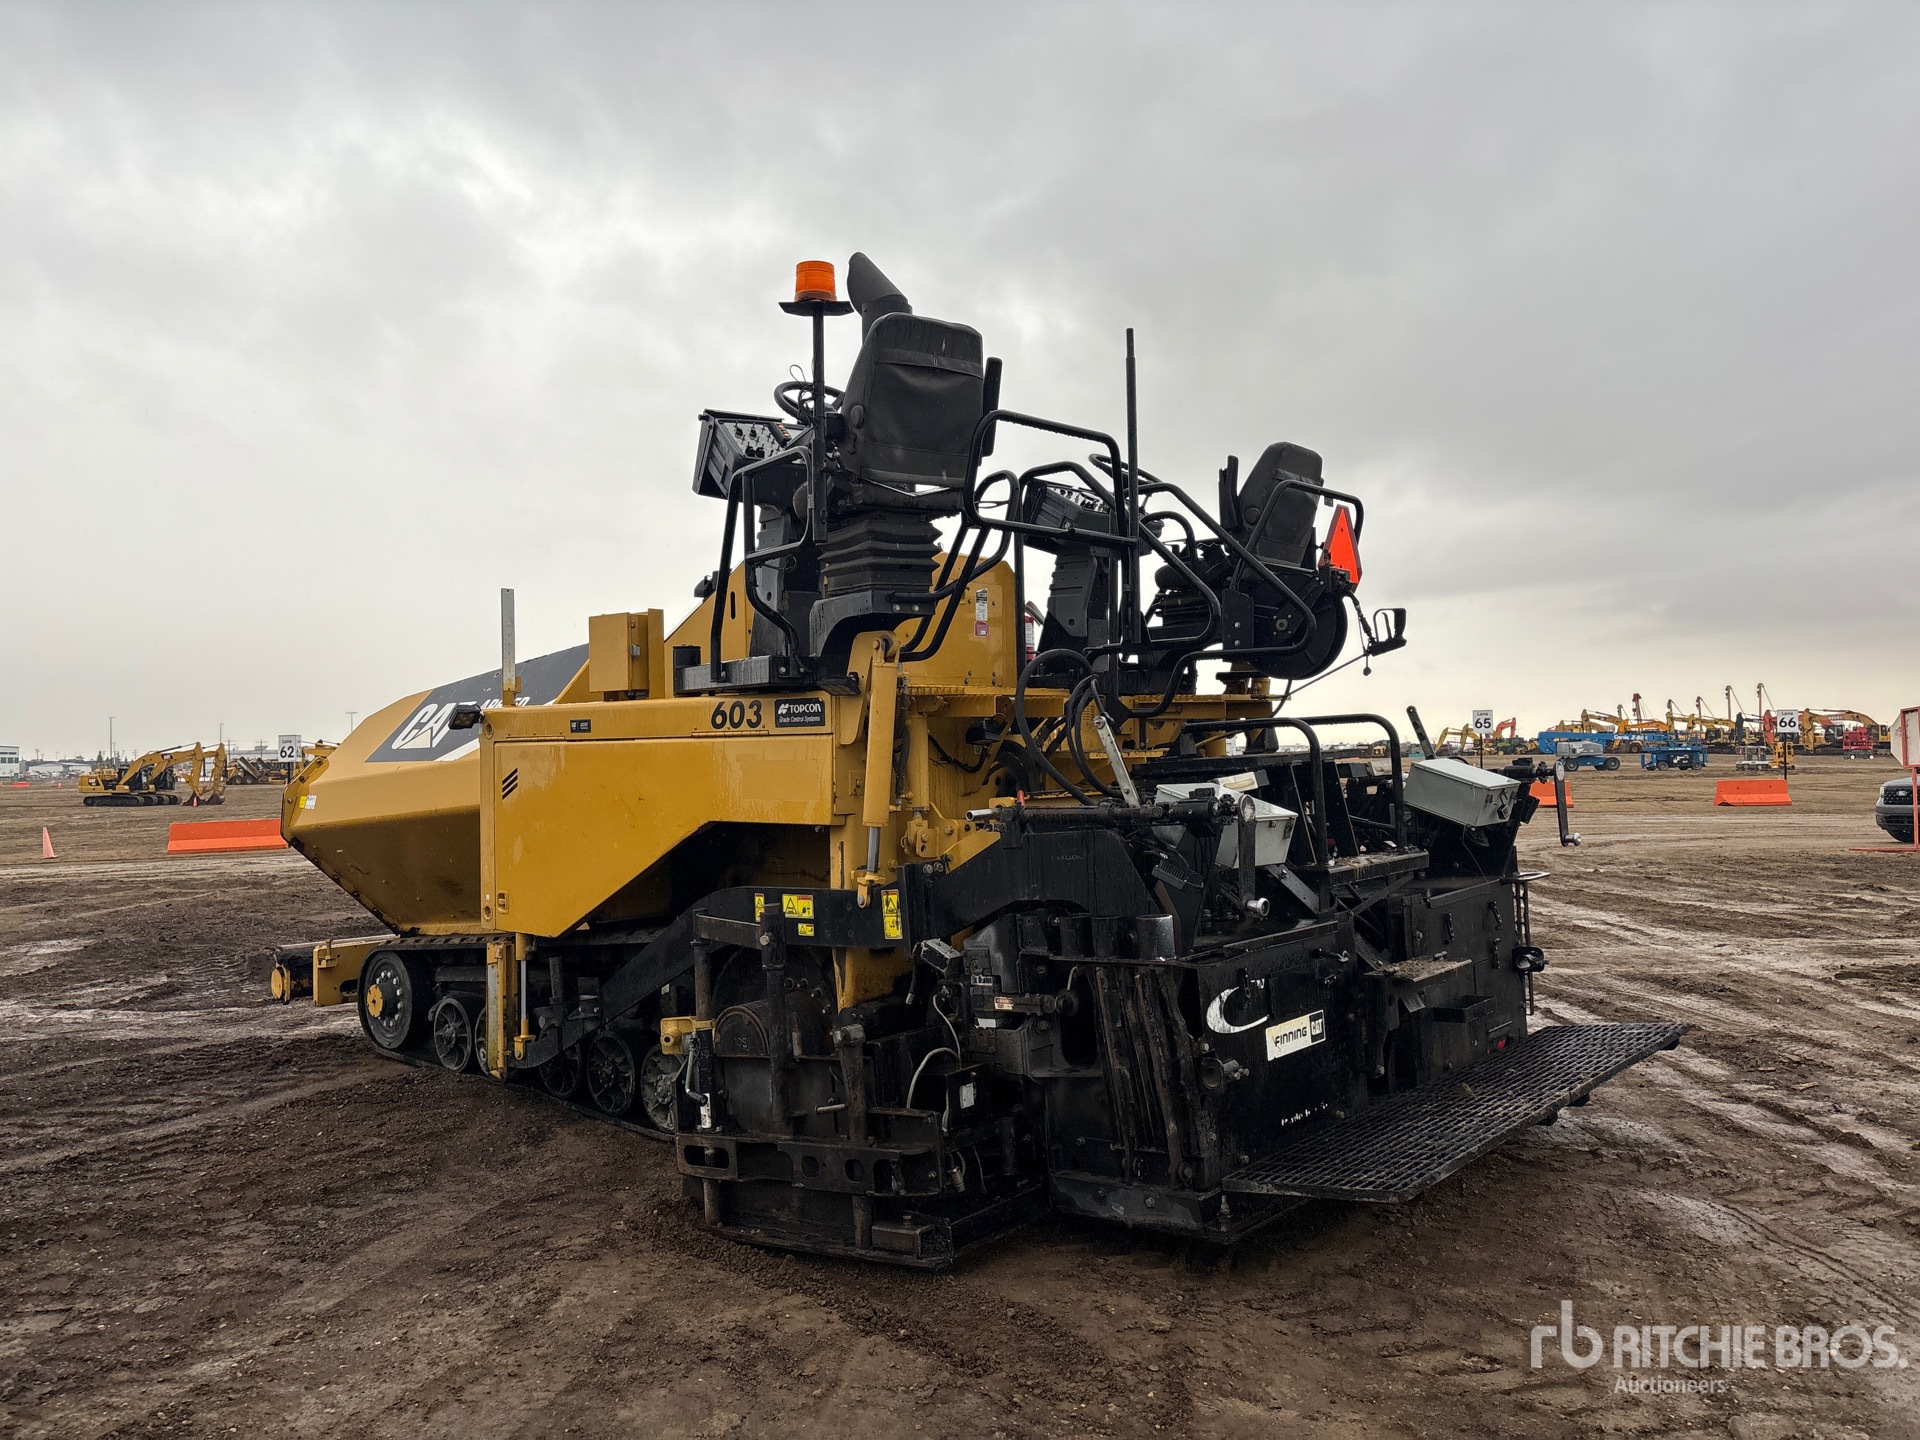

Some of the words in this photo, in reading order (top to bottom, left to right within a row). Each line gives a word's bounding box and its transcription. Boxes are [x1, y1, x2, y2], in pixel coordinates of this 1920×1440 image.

[711, 700, 762, 729] 603
[789, 703, 822, 714] TOPCON
[1474, 718, 1492, 728] 65
[1779, 717, 1797, 728] 66
[280, 745, 295, 758] 62
[1274, 1026, 1308, 1046] FINNING
[1311, 1019, 1322, 1035] CAT
